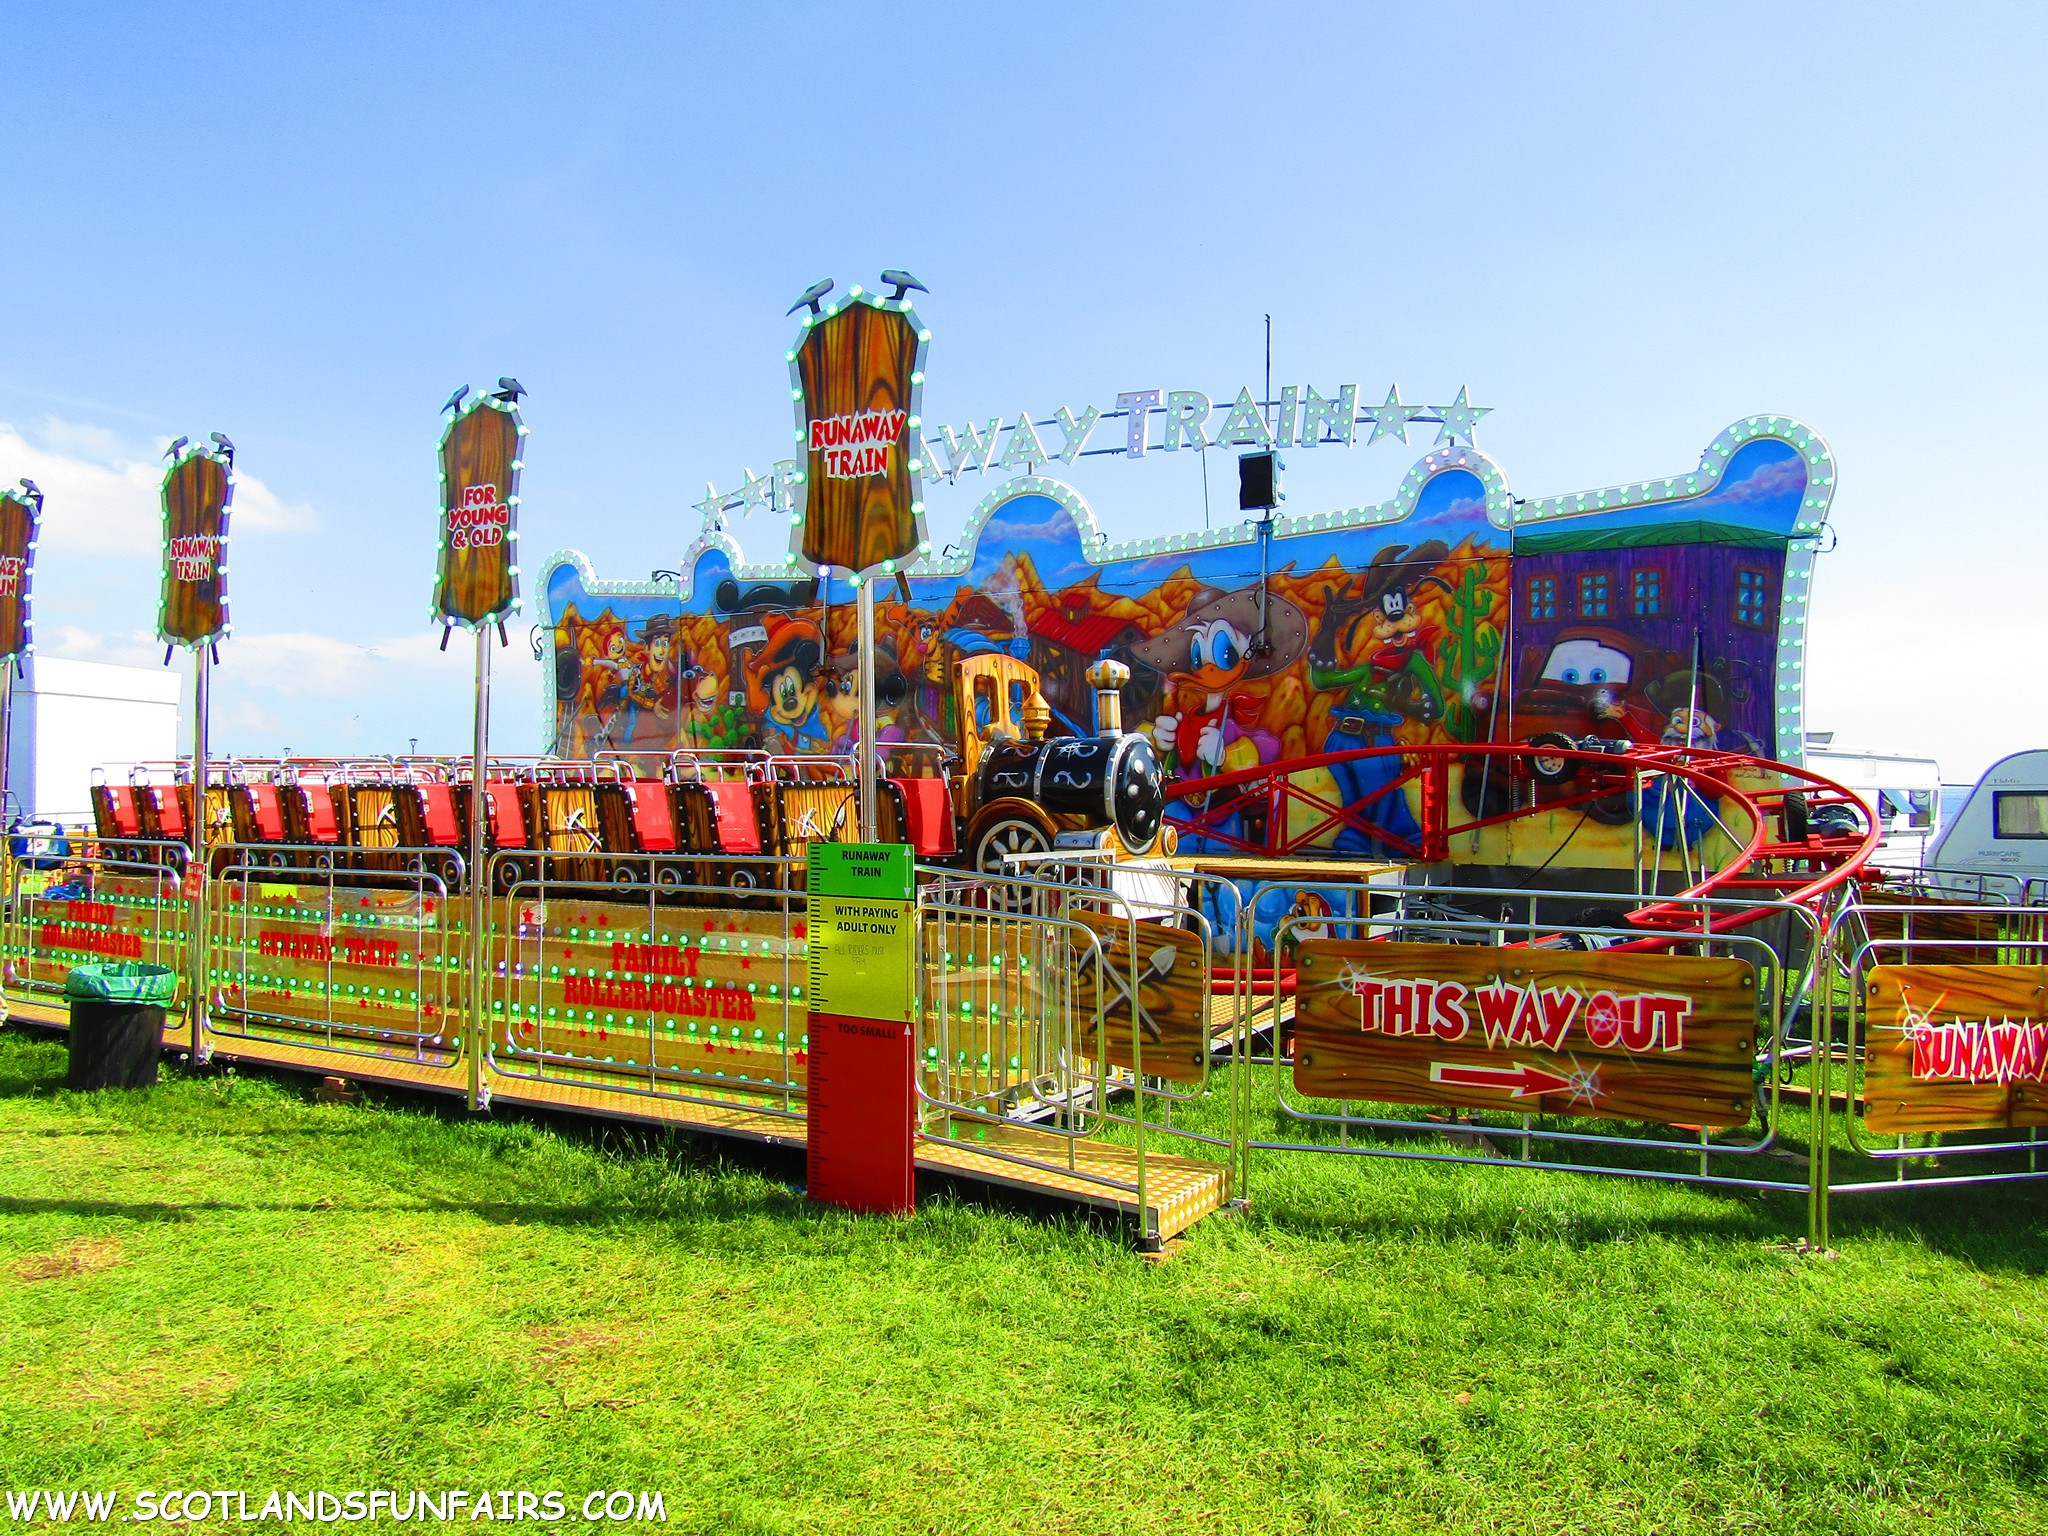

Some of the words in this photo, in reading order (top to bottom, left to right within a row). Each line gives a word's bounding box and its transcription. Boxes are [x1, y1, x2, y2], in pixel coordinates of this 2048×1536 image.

[810, 411, 906, 450] RUNAWAY
[1115, 384, 1360, 459] TRAIN
[825, 445, 888, 479] TRAIN
[464, 485, 497, 507] FOR
[448, 504, 508, 530] YOUNG
[169, 535, 220, 559] RUNAWAY
[453, 530, 469, 548] &
[471, 526, 503, 547] OLD
[178, 560, 210, 580] TRAIN
[842, 850, 891, 862] RUNAWAY
[851, 866, 882, 877] TRAIN
[67, 900, 115, 925] FAMILY
[835, 905, 860, 917] WITH
[862, 907, 899, 919] PAYING
[837, 921, 868, 933] ADULT
[870, 923, 897, 935] ONLY
[42, 924, 142, 958] ROLLERCOASTER
[259, 931, 337, 961] RUNAWAY
[345, 937, 397, 966] TRAIN
[612, 942, 700, 977] FAMILY
[564, 976, 756, 1021] ROLLERCOASTER
[1353, 978, 1469, 1041] THIS
[1475, 976, 1582, 1052] WAY
[1586, 991, 1692, 1052] OUT
[838, 1023, 858, 1035] TOO
[860, 1026, 896, 1039] SMALL!
[1912, 1017, 2048, 1084] RUNAWAY
